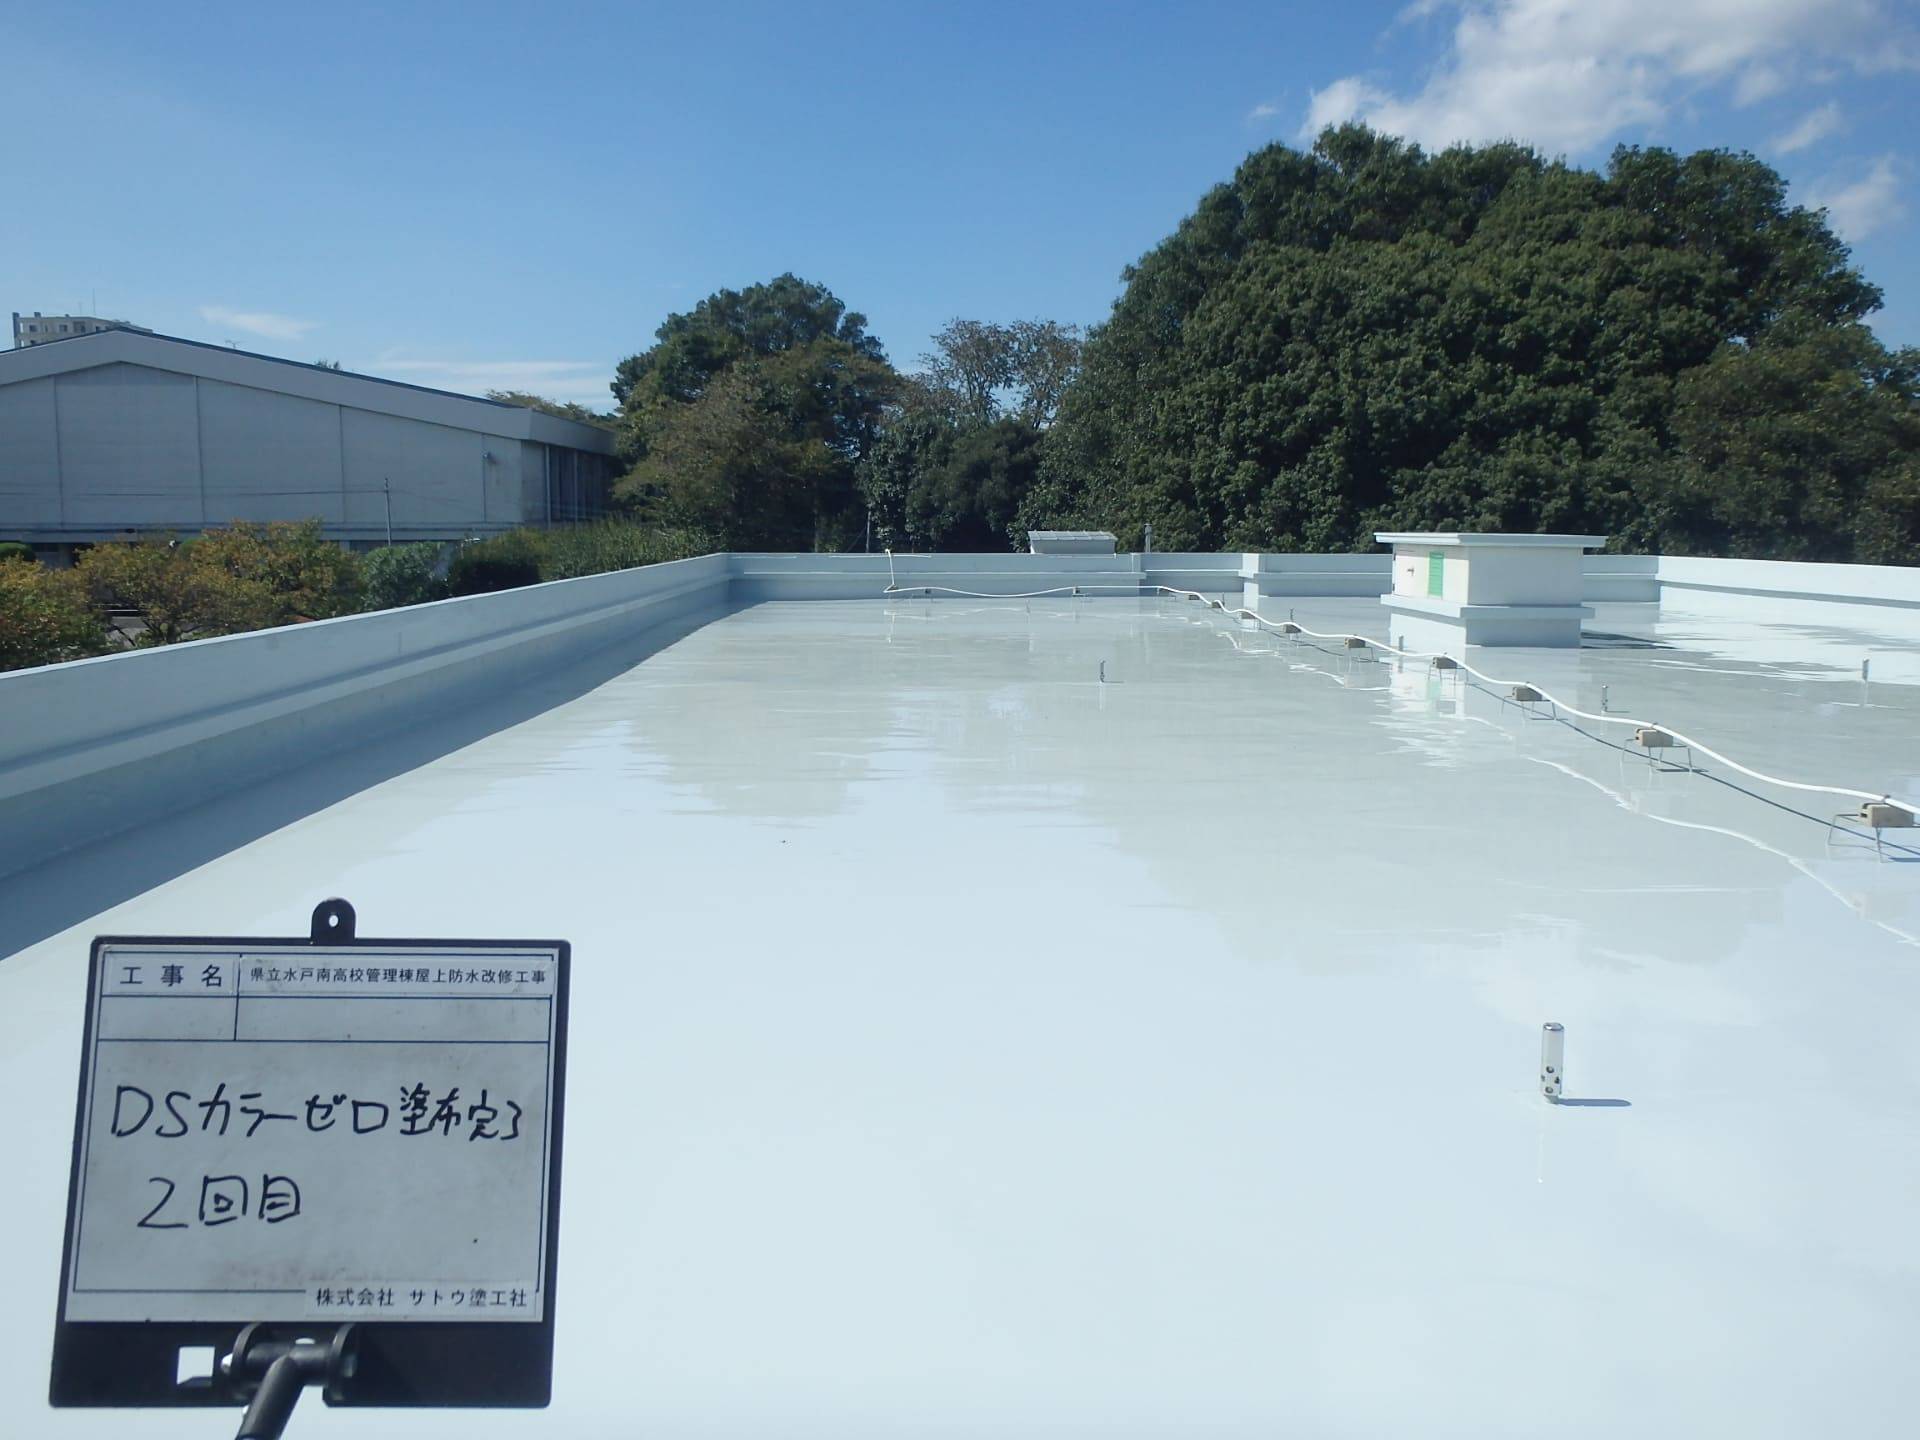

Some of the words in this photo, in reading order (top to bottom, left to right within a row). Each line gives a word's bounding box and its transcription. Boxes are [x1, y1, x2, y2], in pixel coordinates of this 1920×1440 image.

[120, 965, 223, 988] 工事名
[250, 967, 547, 985] 県立水戸南高校管理棟屋上防水改修工事
[137, 1173, 301, 1229] 2回目
[315, 1287, 395, 1308] 株式会社
[408, 1287, 528, 1308] サトウ塗工社
